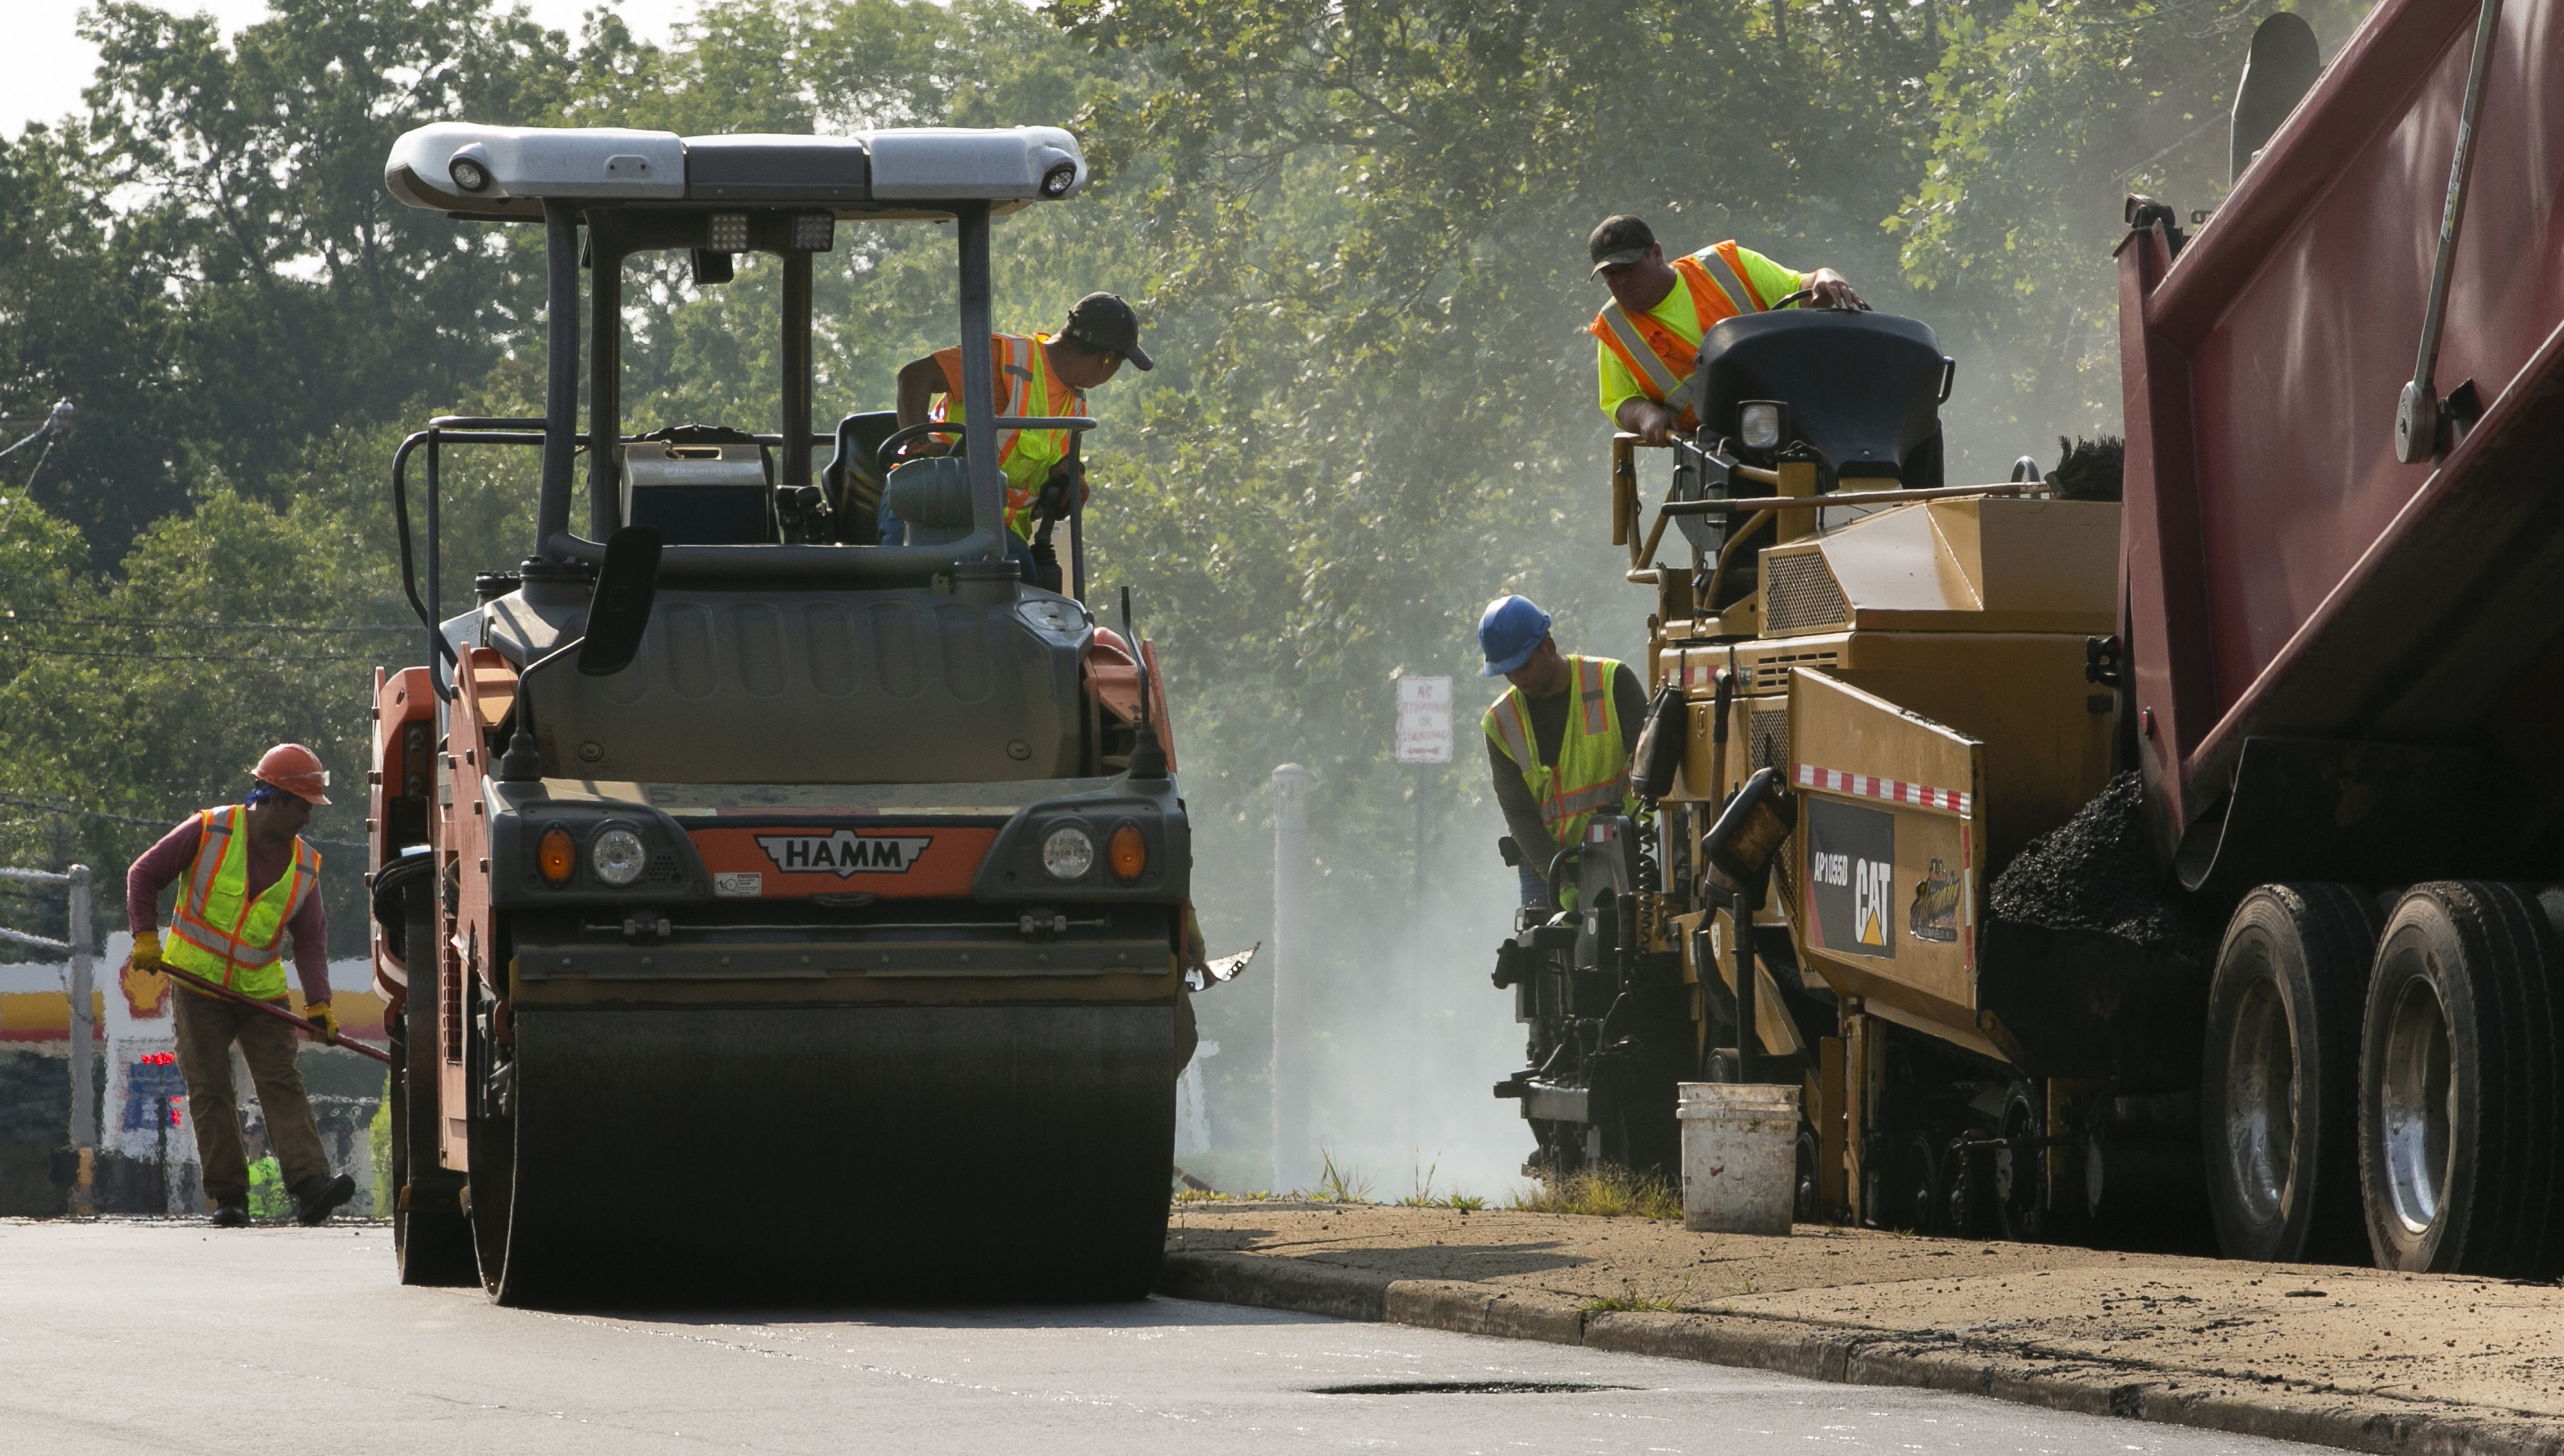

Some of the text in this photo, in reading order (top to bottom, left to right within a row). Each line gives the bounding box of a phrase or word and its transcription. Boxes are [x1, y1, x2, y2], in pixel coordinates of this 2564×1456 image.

[786, 840, 902, 867] HAMM
[1814, 851, 1848, 886] AP1055D
[1855, 858, 1891, 946] CAT
